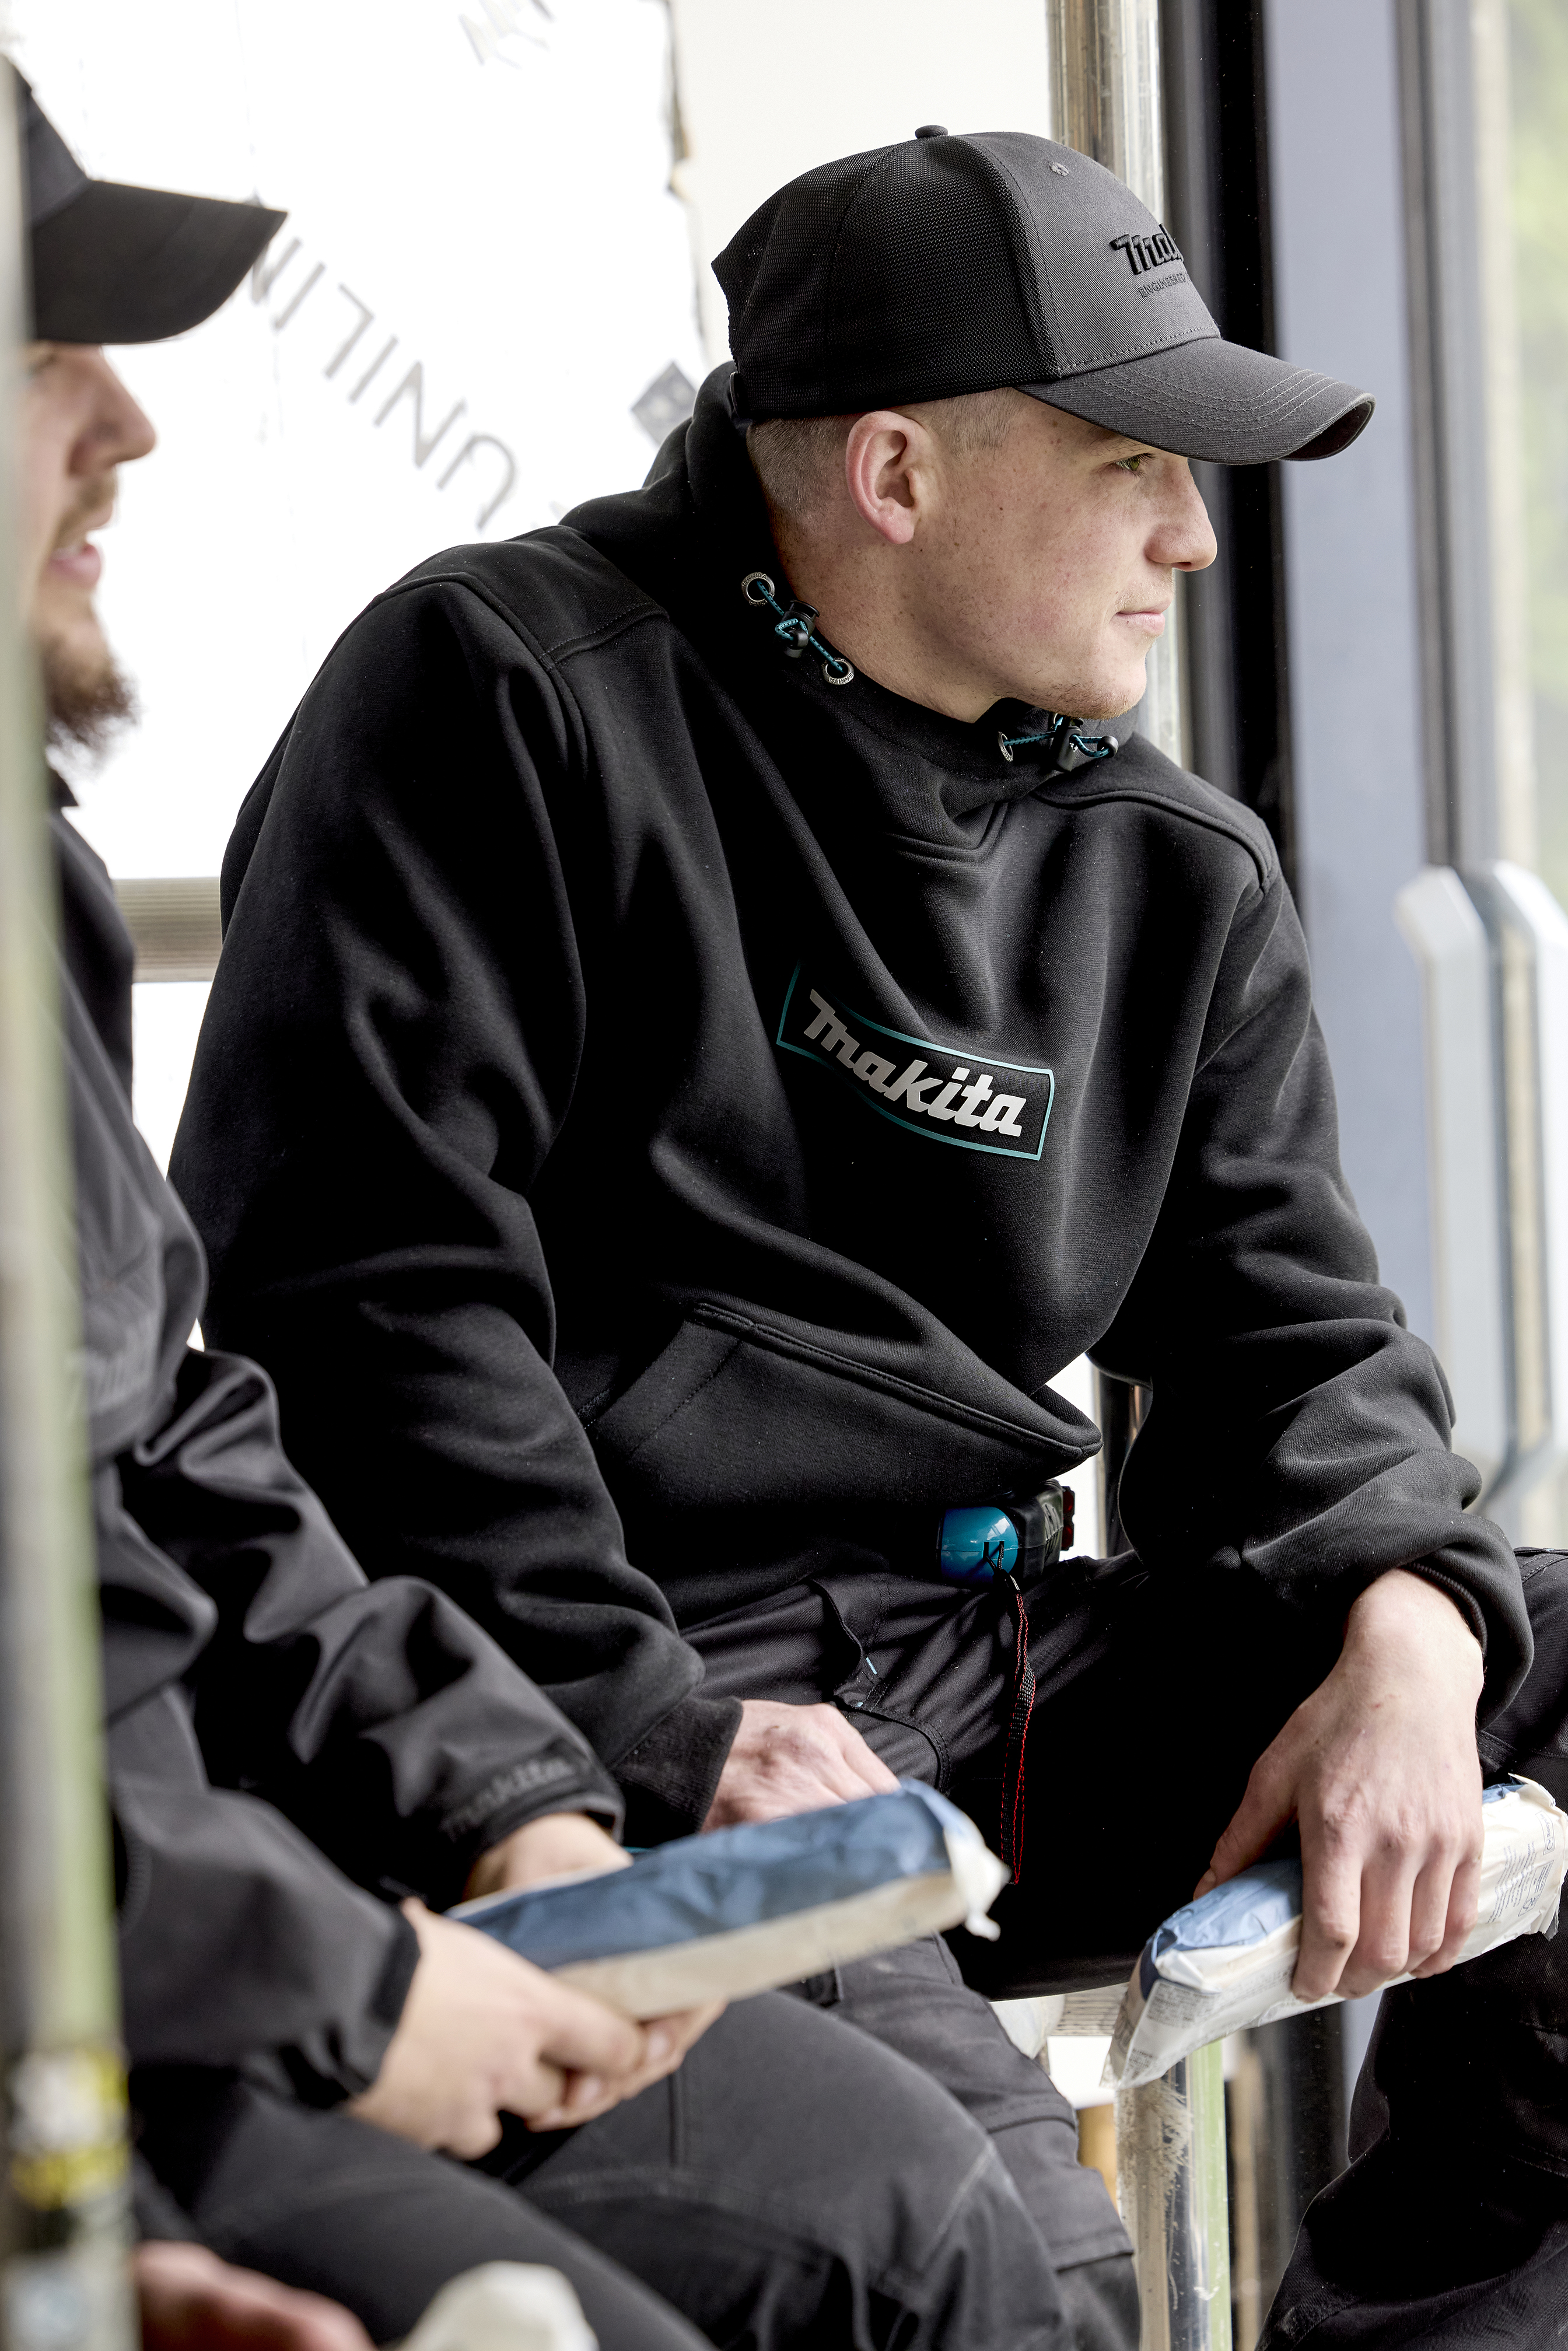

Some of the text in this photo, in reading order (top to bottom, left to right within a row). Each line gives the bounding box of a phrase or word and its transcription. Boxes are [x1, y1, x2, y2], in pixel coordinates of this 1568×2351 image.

[741, 572, 767, 587] MAKITA
[829, 671, 855, 685] MAKITA
[804, 989, 1026, 1137] makita
[1540, 1814, 1551, 1838] Recycle
